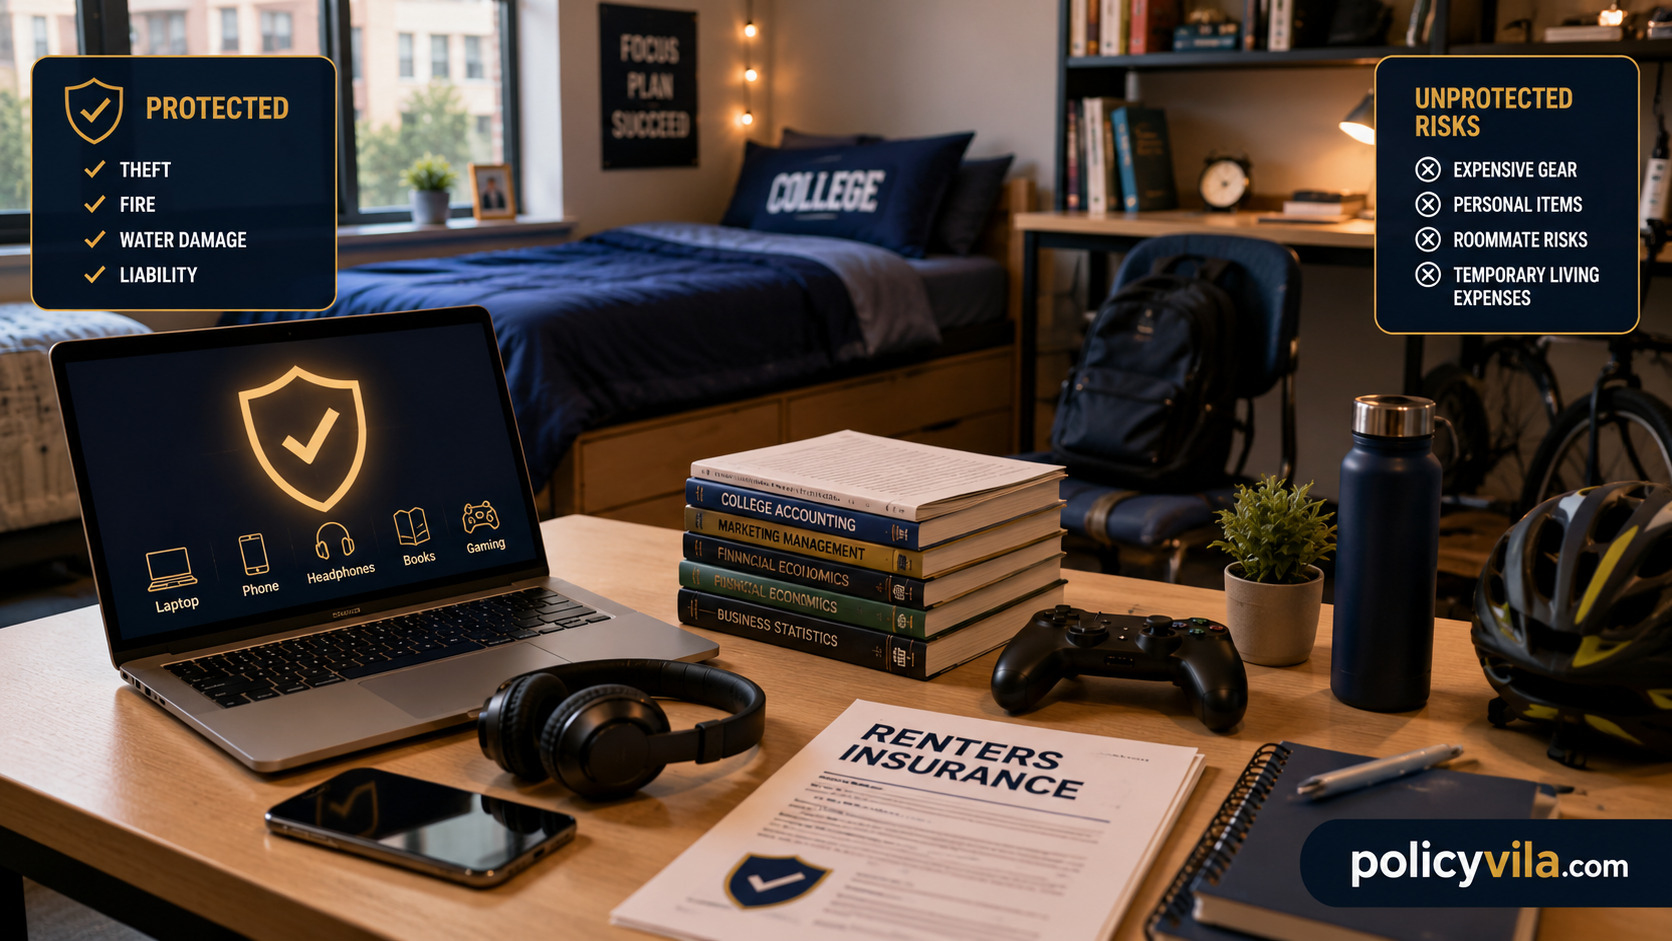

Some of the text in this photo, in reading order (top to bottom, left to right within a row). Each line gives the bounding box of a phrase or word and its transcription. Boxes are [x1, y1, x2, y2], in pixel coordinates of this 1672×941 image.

[620, 33, 680, 65] FOCUS
[627, 71, 674, 100] PLAN
[612, 110, 690, 139] SUCCEED
[767, 169, 886, 215] COLLEGE
[721, 492, 857, 532] COLLEGE ACCOUNTING
[466, 537, 506, 556] Gaming
[718, 518, 866, 561] MARKETING MANAGEMENT
[306, 561, 376, 585] Headphones
[403, 551, 436, 567] Books
[242, 579, 280, 597] Phone
[155, 594, 201, 615] Laptop
[717, 607, 839, 648] BUSINESS STATISTICS
[861, 723, 1064, 770] RENTERS
[839, 744, 1084, 801] INSURANCE
